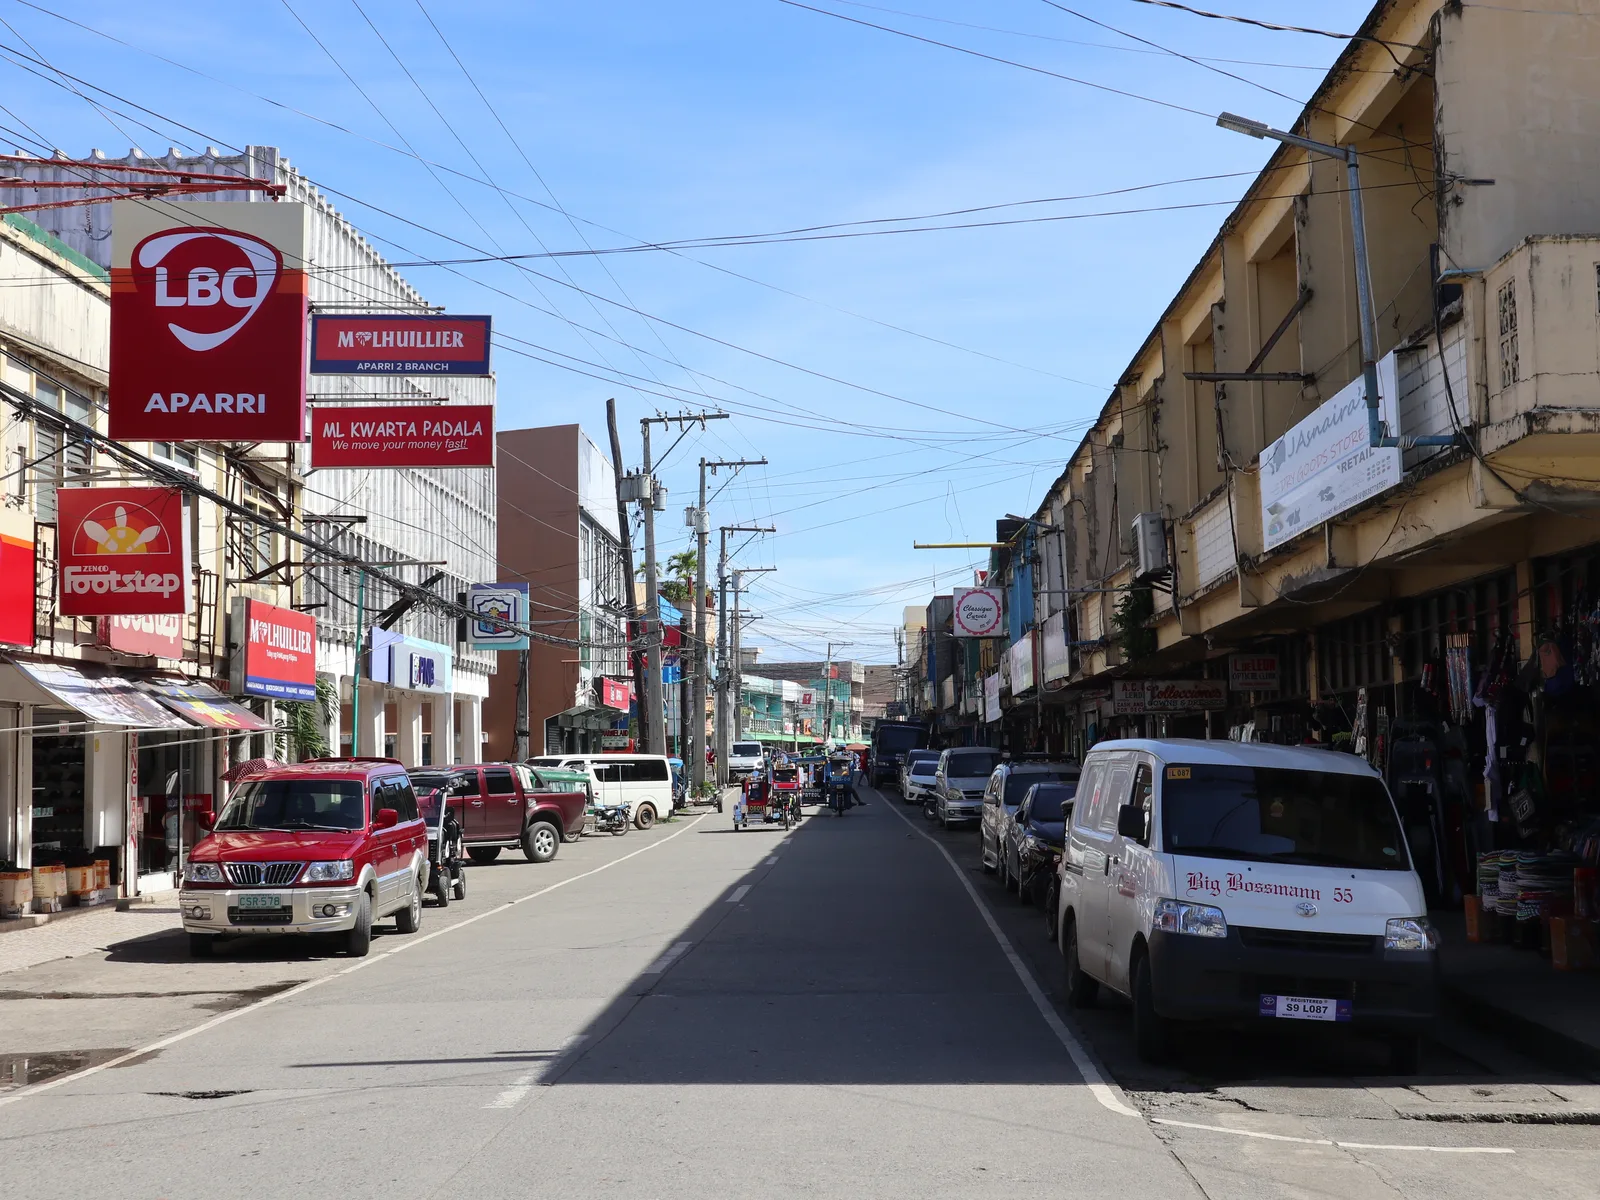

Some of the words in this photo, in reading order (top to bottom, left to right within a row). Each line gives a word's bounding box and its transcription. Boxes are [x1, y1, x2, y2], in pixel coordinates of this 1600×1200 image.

[156, 266, 258, 308] LBC
[357, 362, 395, 372] APARRI
[396, 362, 403, 372] 2
[405, 362, 449, 372] BRANCH
[144, 393, 266, 414] APARRI
[322, 422, 347, 438] ML
[350, 421, 418, 438] KWARTA
[423, 420, 483, 438] PADALA
[332, 440, 349, 451] We
[352, 441, 380, 450] move
[382, 441, 405, 452] your
[407, 441, 441, 452] money
[442, 438, 468, 452] fast!
[1295, 451, 1329, 484] GOODS
[1329, 424, 1366, 461] STORE
[1340, 446, 1376, 474] RETAIL
[963, 604, 993, 613] Classique
[966, 612, 988, 621] Curves
[418, 656, 435, 689] PNB
[1177, 769, 1191, 777] 087
[1185, 871, 1222, 898] Big
[1225, 872, 1322, 901] Bossmann
[1333, 887, 1354, 904] 55
[1286, 1003, 1300, 1012] S9
[1303, 1005, 1329, 1014] L087
